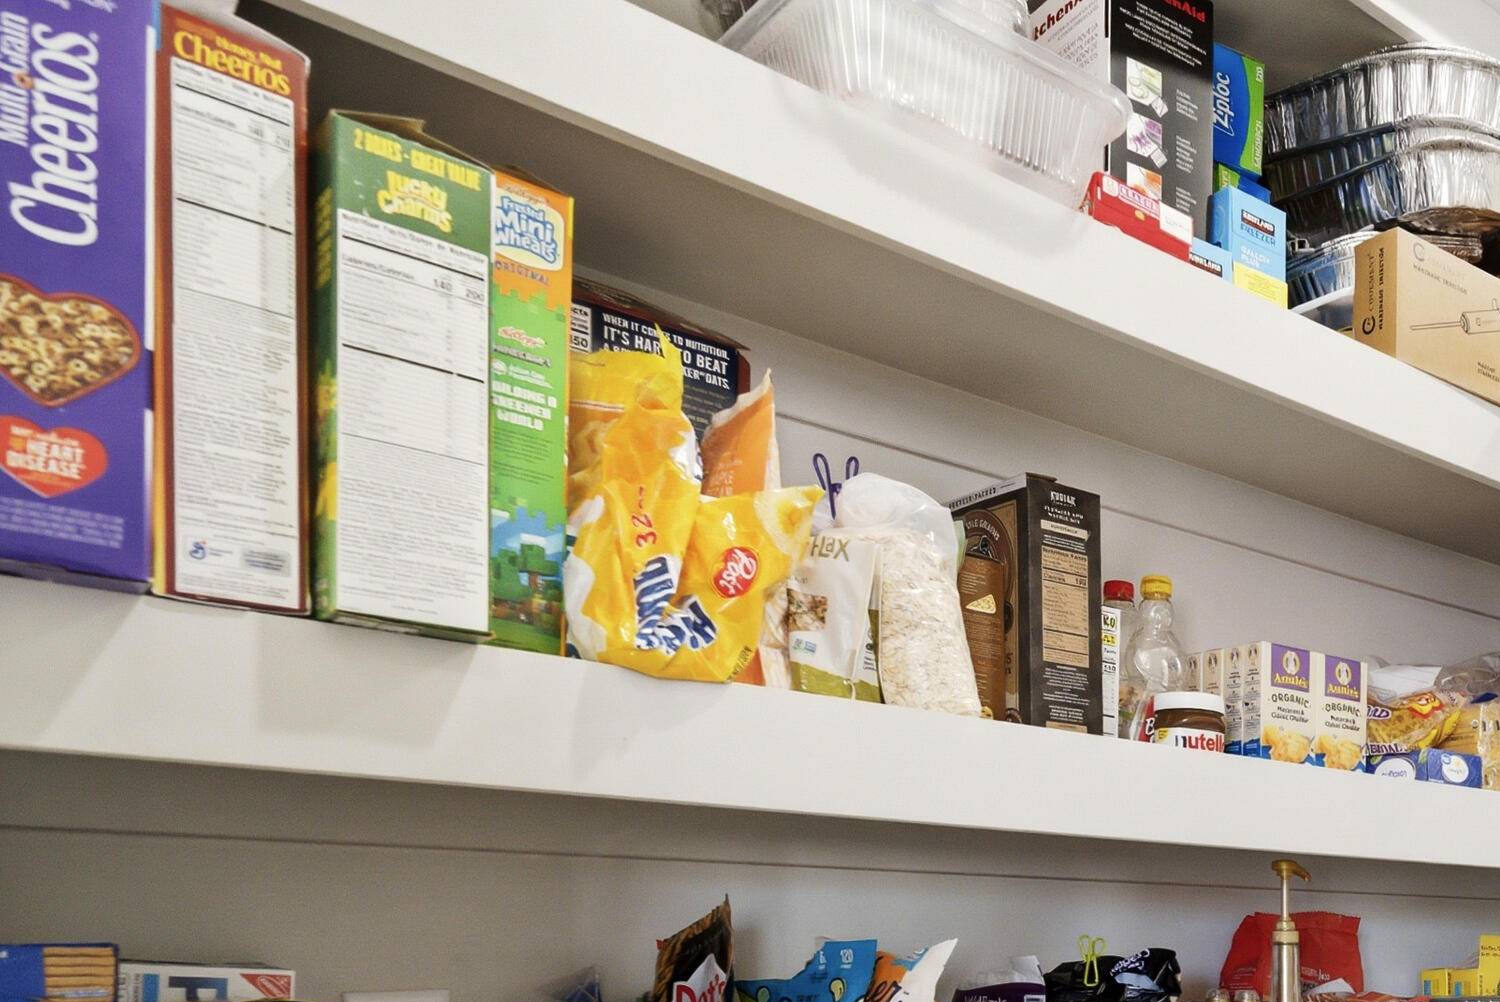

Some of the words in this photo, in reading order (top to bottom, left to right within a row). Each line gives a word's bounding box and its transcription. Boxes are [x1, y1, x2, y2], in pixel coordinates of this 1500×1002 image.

[172, 30, 291, 97] Cheerios
[1213, 71, 1232, 132] Ziploc
[8, 23, 99, 247] Cheerios
[501, 196, 546, 221] Frosted
[496, 204, 555, 244] Mini
[631, 320, 640, 332] IT
[603, 326, 631, 346] IT'S
[695, 357, 729, 376] BEAT
[26, 440, 84, 464] HEART
[6, 451, 83, 481] DISEASE
[1274, 672, 1309, 690] Annie's
[1327, 684, 1360, 700] Annie's
[1271, 693, 1310, 709] ORGANIC
[1325, 702, 1361, 718] ORGANIC
